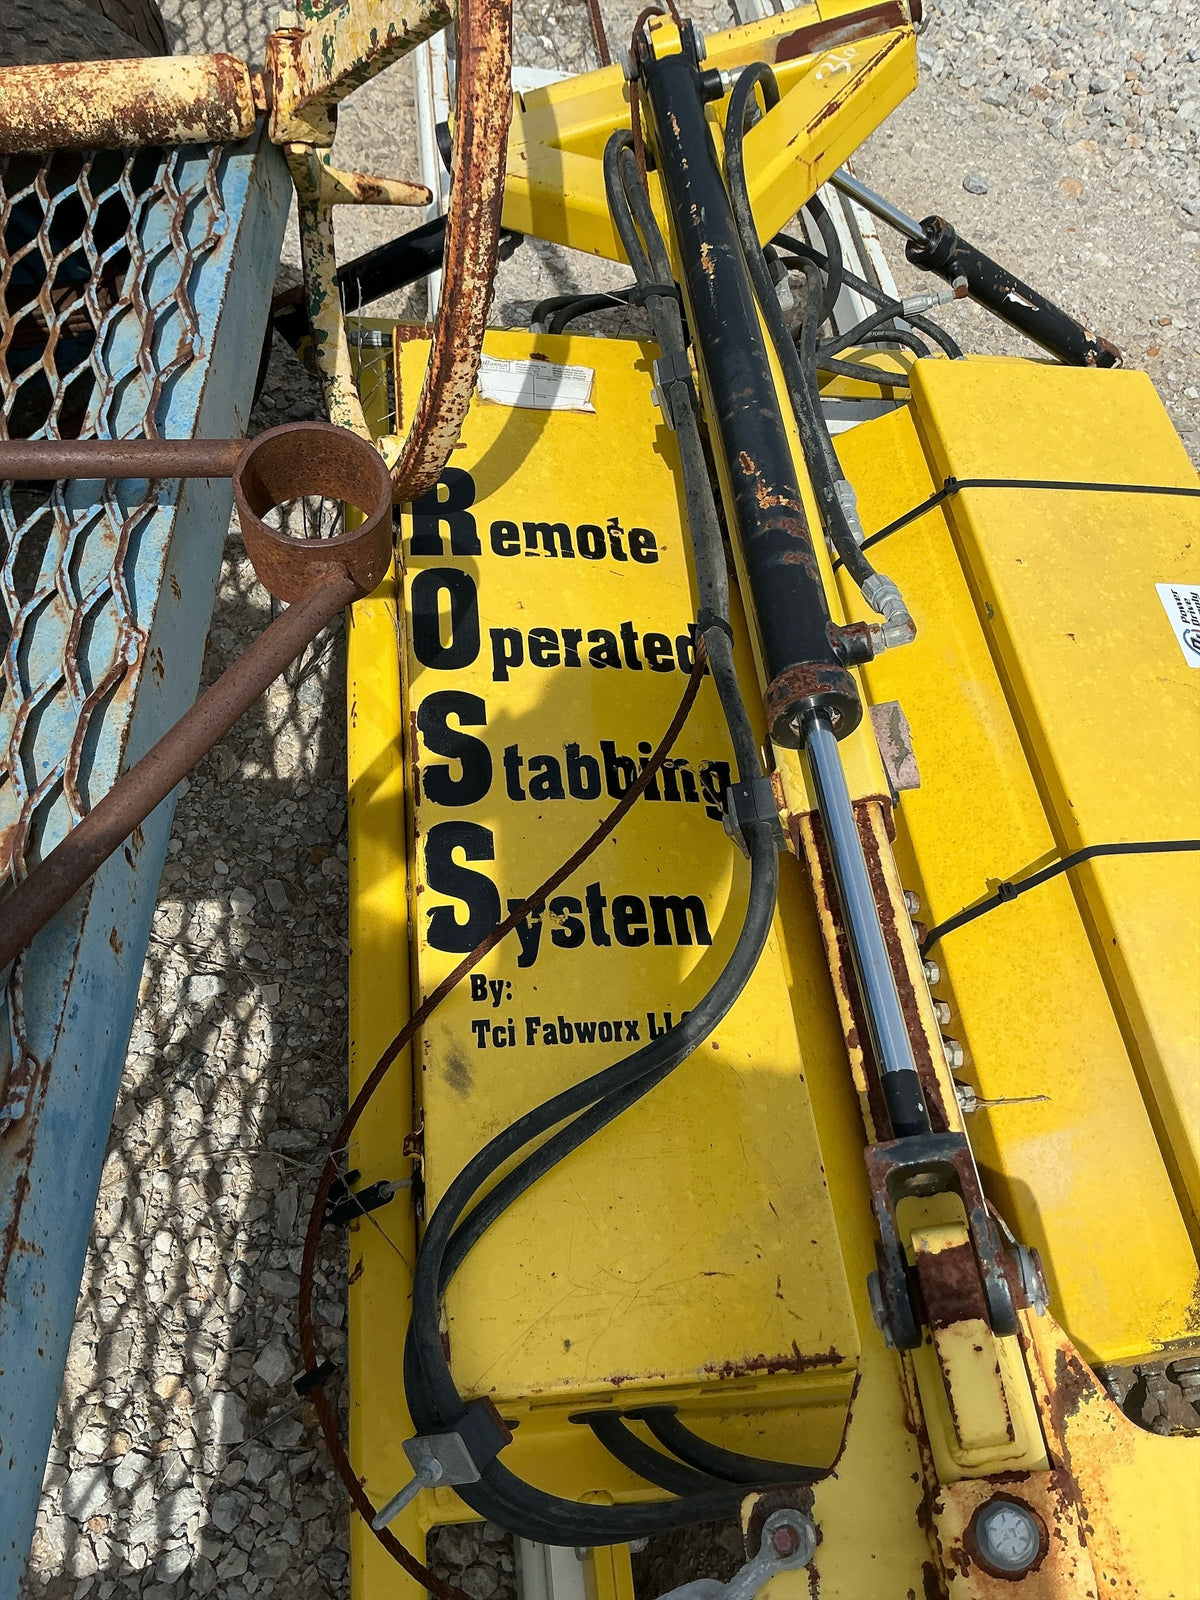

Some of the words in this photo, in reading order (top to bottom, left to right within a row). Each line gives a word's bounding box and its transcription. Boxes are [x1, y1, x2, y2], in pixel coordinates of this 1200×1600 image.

[409, 466, 659, 564] Remote
[411, 567, 710, 682] Operated
[1170, 588, 1191, 624] Power
[417, 690, 731, 822] Stabbing
[424, 820, 713, 968] System
[470, 974, 513, 1008] By:
[471, 1018, 516, 1049] Tci
[525, 1015, 640, 1046] Fabworx
[647, 1011, 690, 1041] LL
